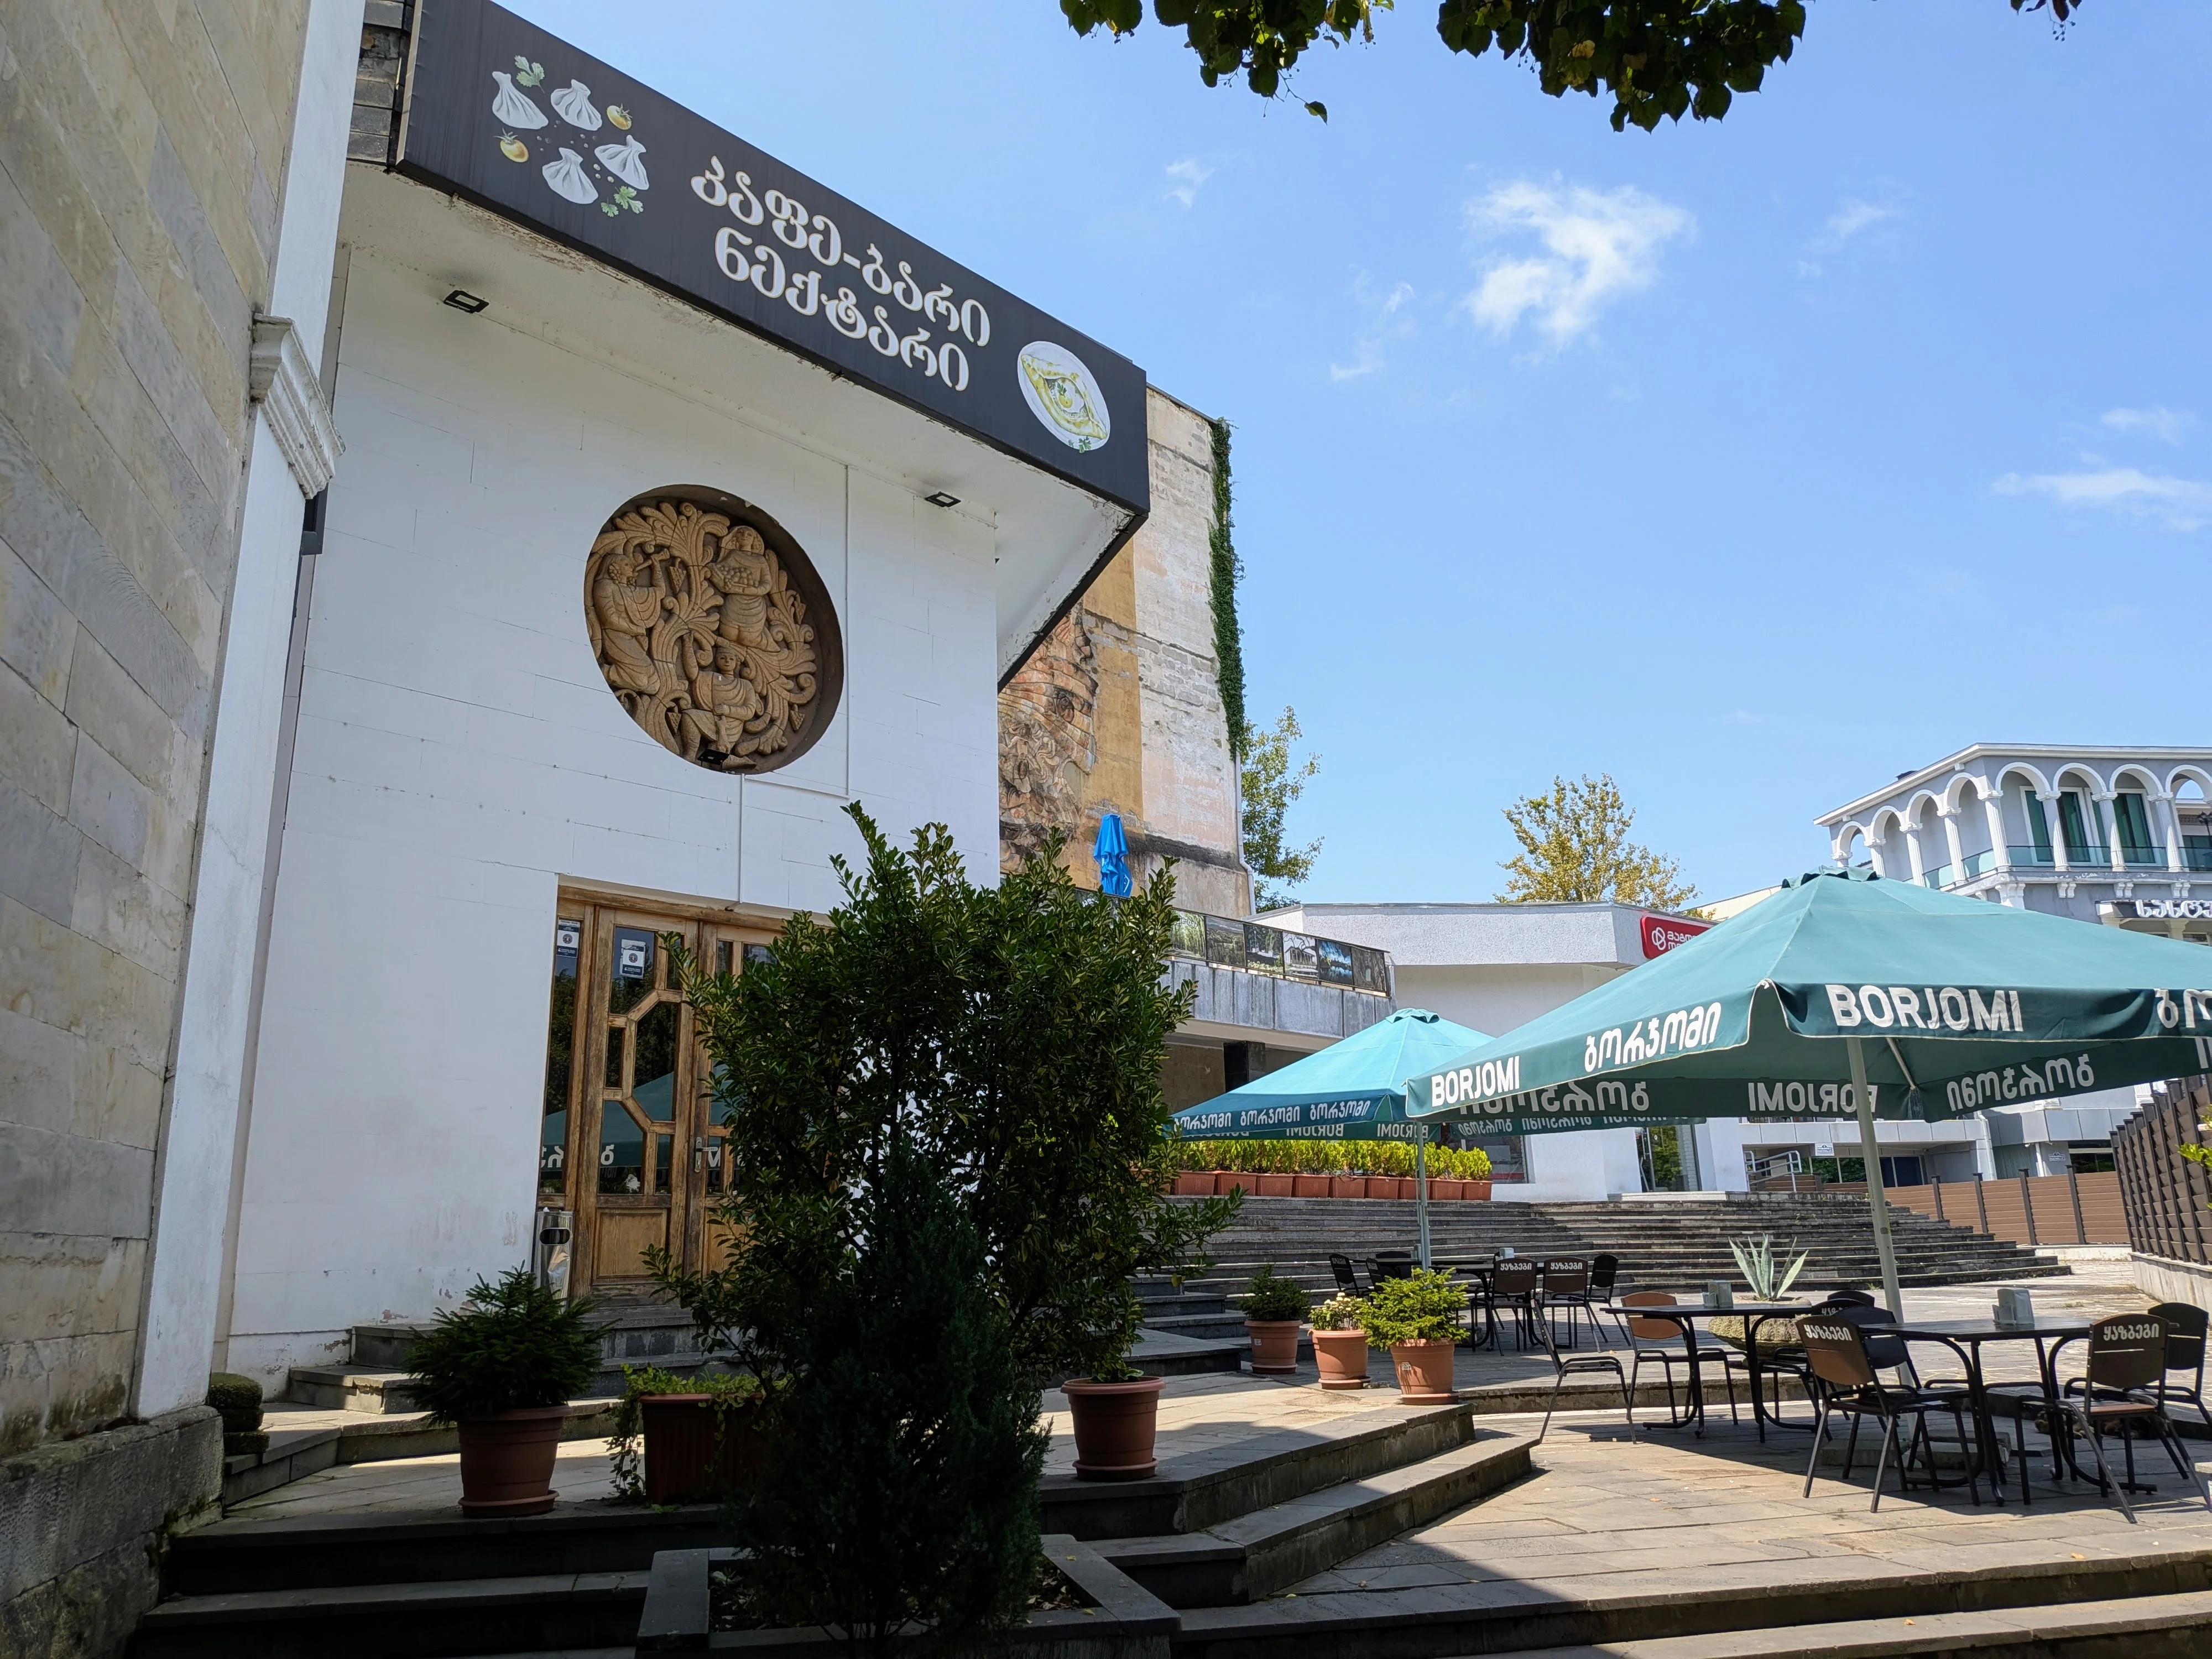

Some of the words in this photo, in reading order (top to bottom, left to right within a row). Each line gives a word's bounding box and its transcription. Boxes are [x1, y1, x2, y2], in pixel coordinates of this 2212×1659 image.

[691, 155, 990, 346] კაფე-ბარი
[715, 227, 969, 391] ნექტარი
[1825, 985, 2023, 1031] BORJOMI
[1431, 1056, 1520, 1107] BORJOMI
[1584, 1002, 1721, 1072] ბორჯომი
[1240, 1108, 1300, 1126] ბორჯომი
[1310, 1100, 1370, 1120] ბორჯომი
[1500, 1262, 1532, 1271] ყაზბეგი
[1550, 1262, 1583, 1270] ყაზბეგი
[1803, 1324, 1853, 1341] ყაზბეგი
[2103, 1323, 2159, 1341] ყაზბეგი
